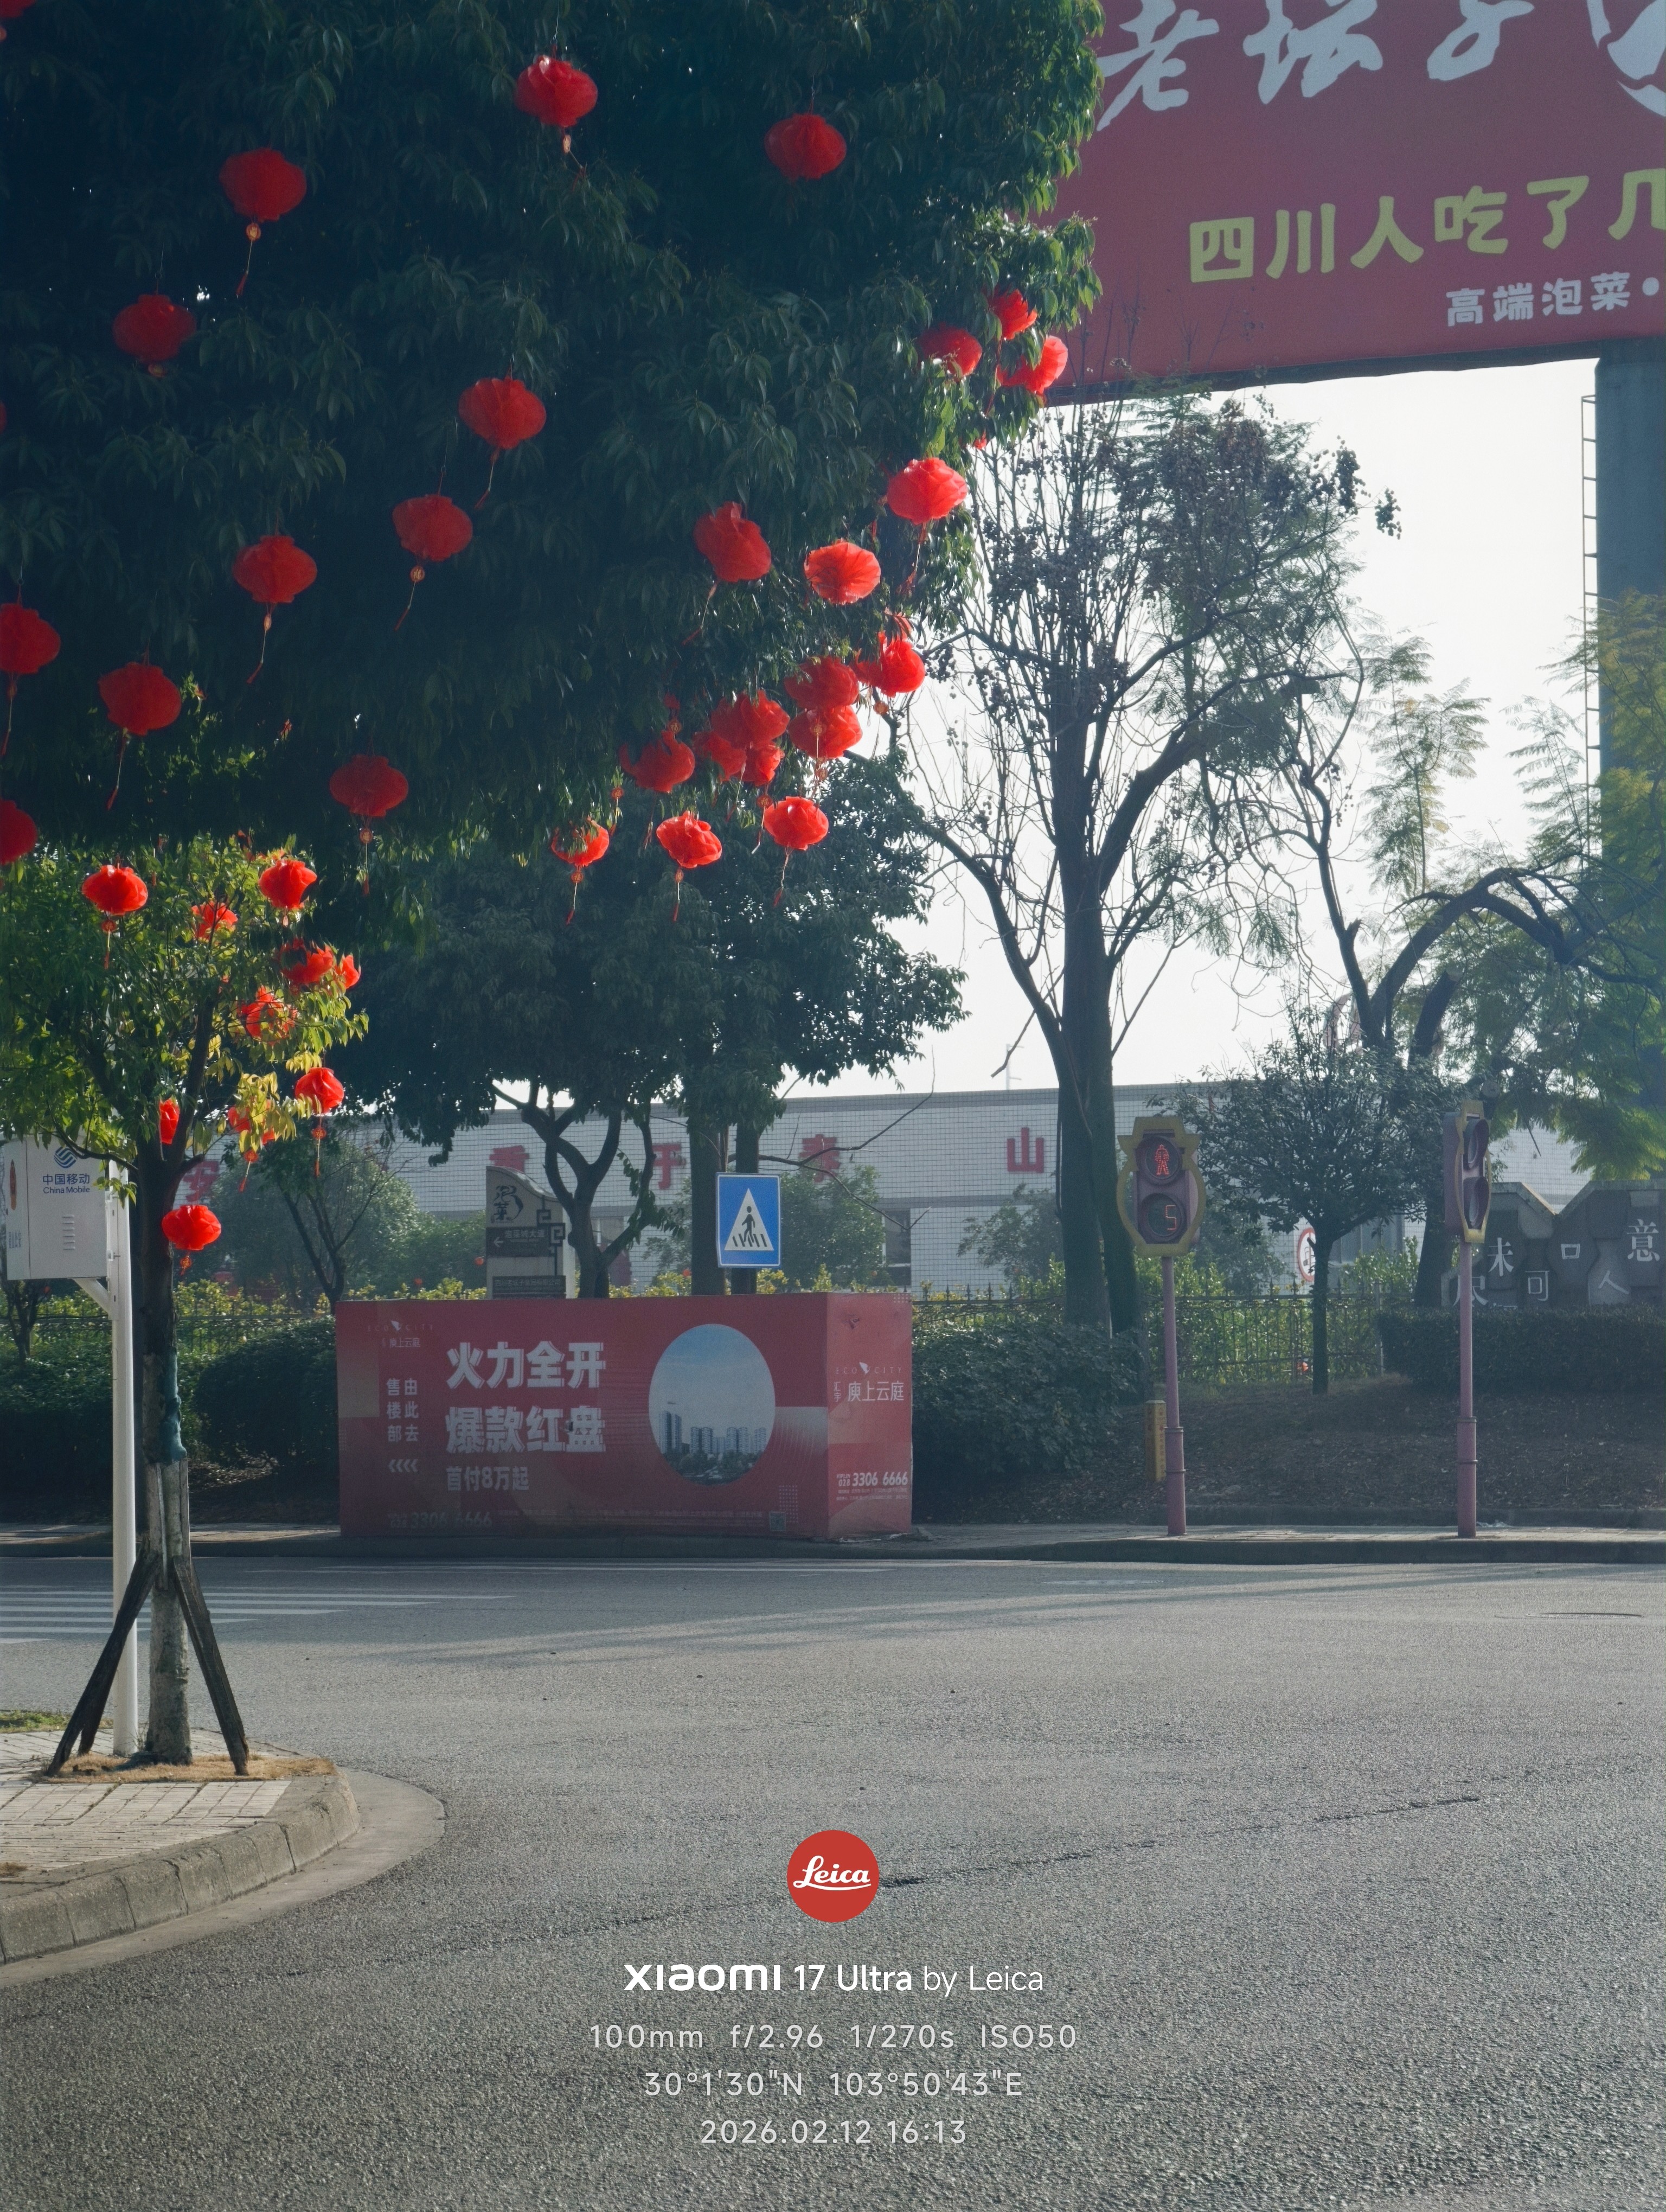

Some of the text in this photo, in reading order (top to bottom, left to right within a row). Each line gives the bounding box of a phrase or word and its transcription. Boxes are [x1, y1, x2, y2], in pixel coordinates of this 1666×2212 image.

[1189, 168, 1666, 283] 四川人吃了几
[1007, 1127, 1044, 1174] 山
[43, 1173, 90, 1185] 中国移动
[1165, 1205, 1177, 1231] 5
[1627, 1219, 1660, 1262] 意
[1525, 1270, 1550, 1301] 可
[1598, 1270, 1630, 1295] 人
[446, 1341, 606, 1390] 火力全开
[386, 1378, 402, 1443] 售楼部
[404, 1378, 419, 1443] 由此去
[445, 1405, 606, 1454] 爆款红盘
[446, 1466, 529, 1492] 首付8万起
[852, 1472, 878, 1487] 3306
[882, 1472, 908, 1486] 6666
